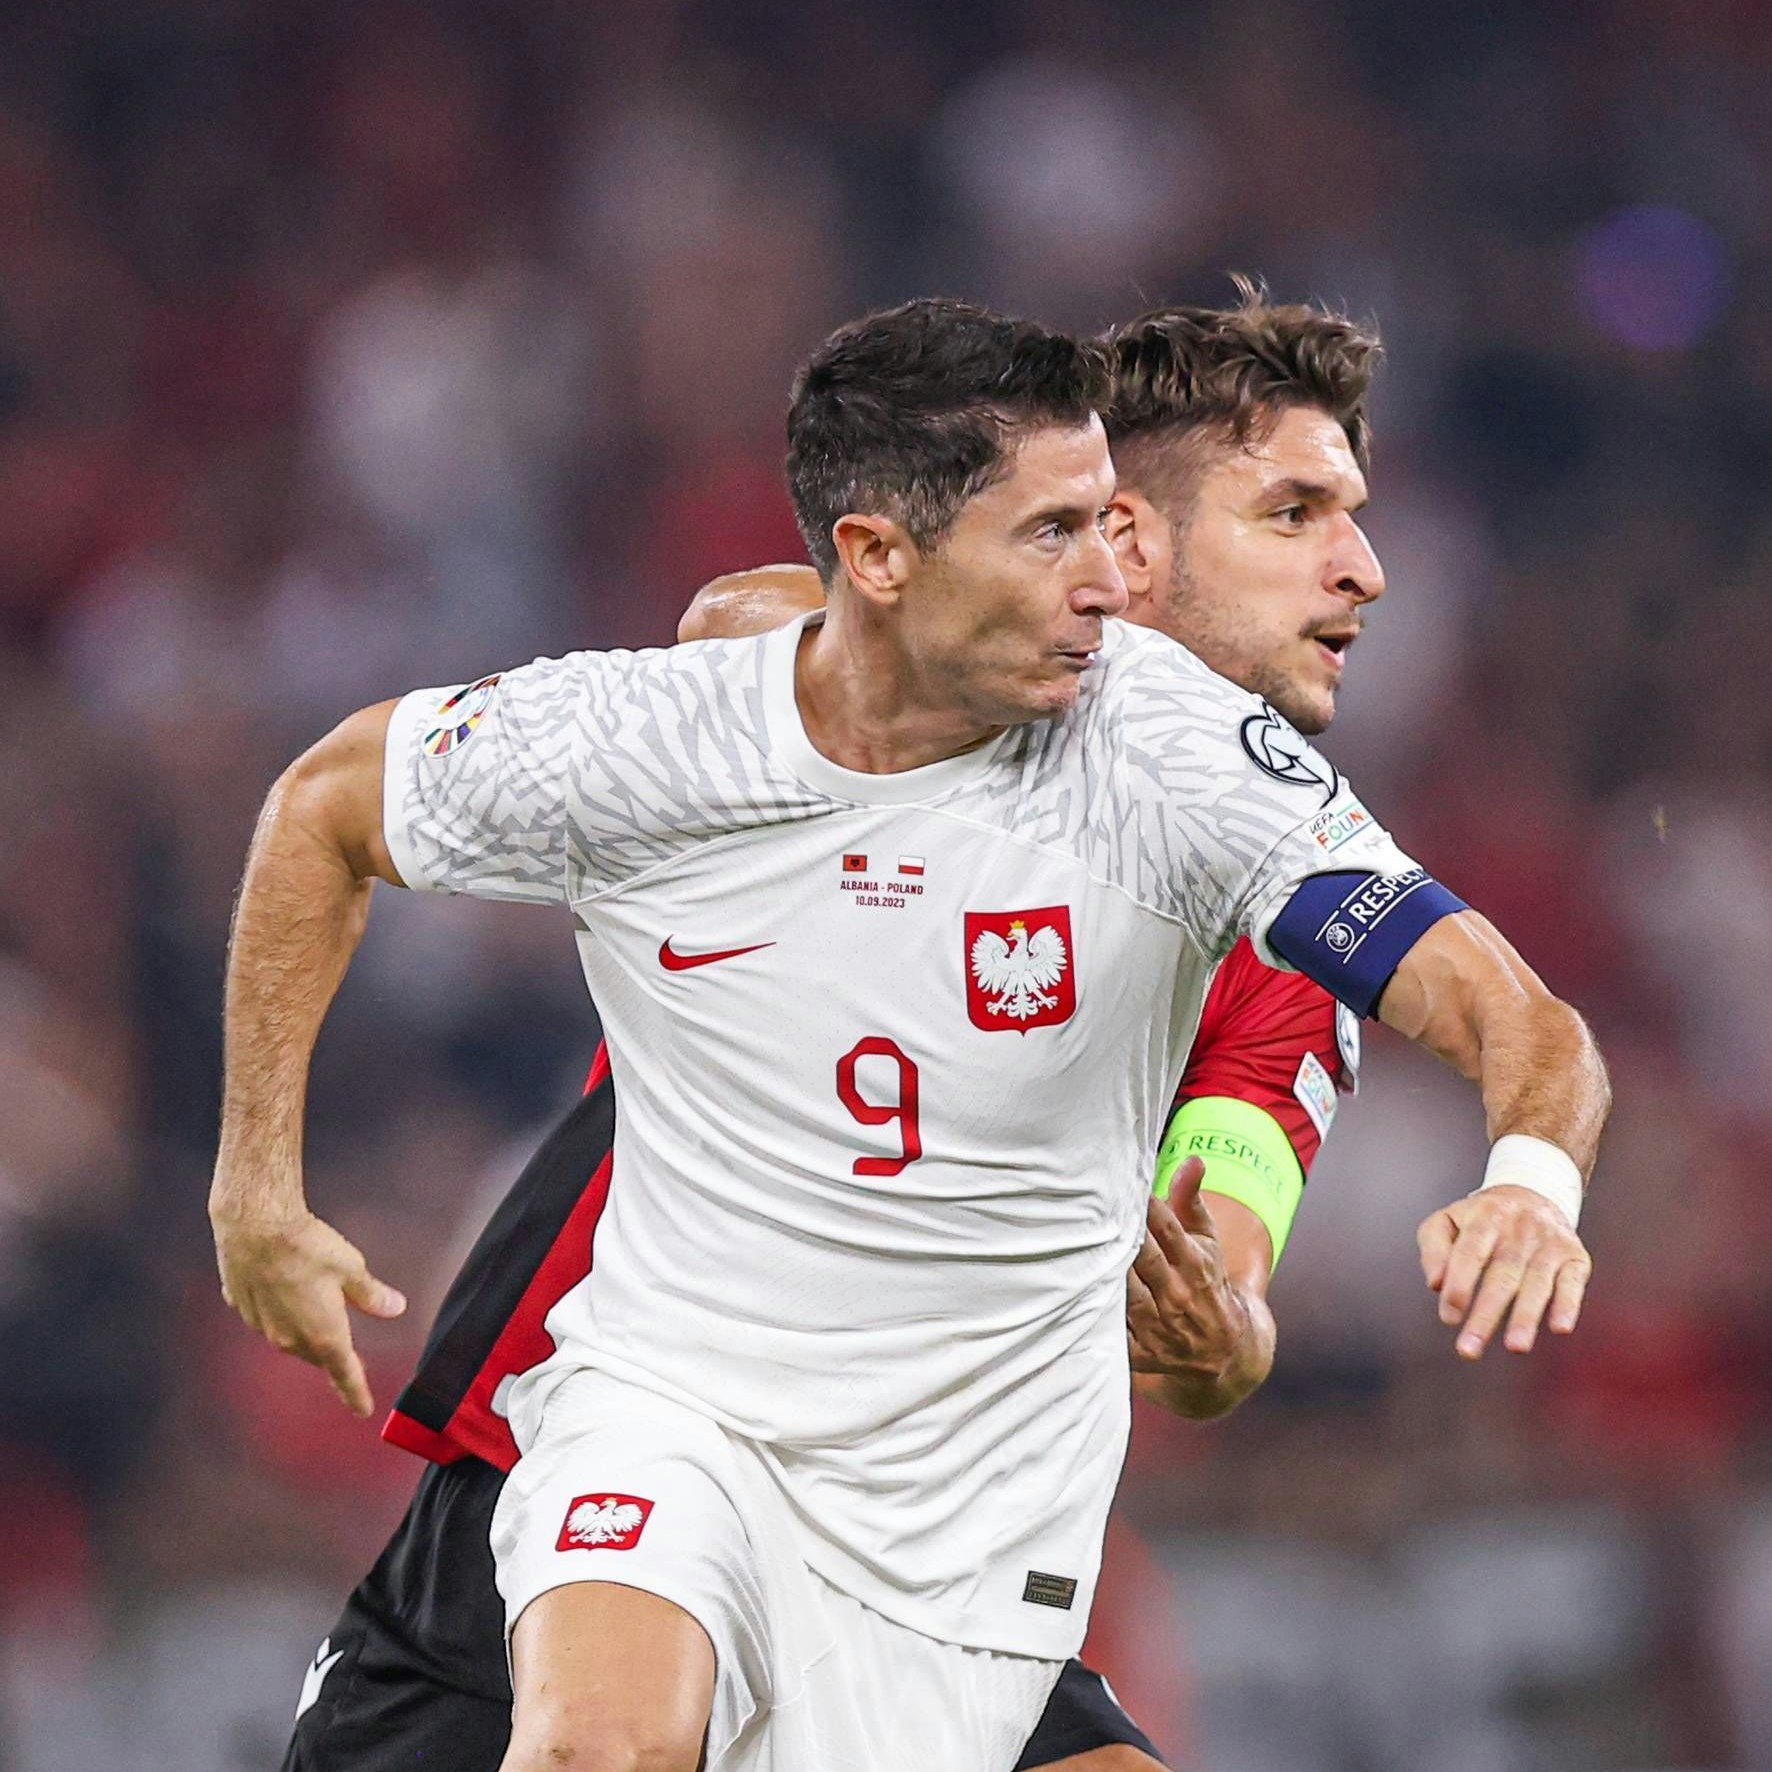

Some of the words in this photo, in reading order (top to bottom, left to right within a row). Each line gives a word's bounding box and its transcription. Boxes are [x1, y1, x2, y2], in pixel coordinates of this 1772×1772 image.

[1309, 812, 1334, 835] UEFA
[840, 881, 878, 892] ALBANIA
[887, 883, 924, 895] POLAND
[855, 895, 905, 908] 10.09.2023
[836, 1036, 922, 1177] 9
[1189, 1136, 1282, 1193] RESPECT
